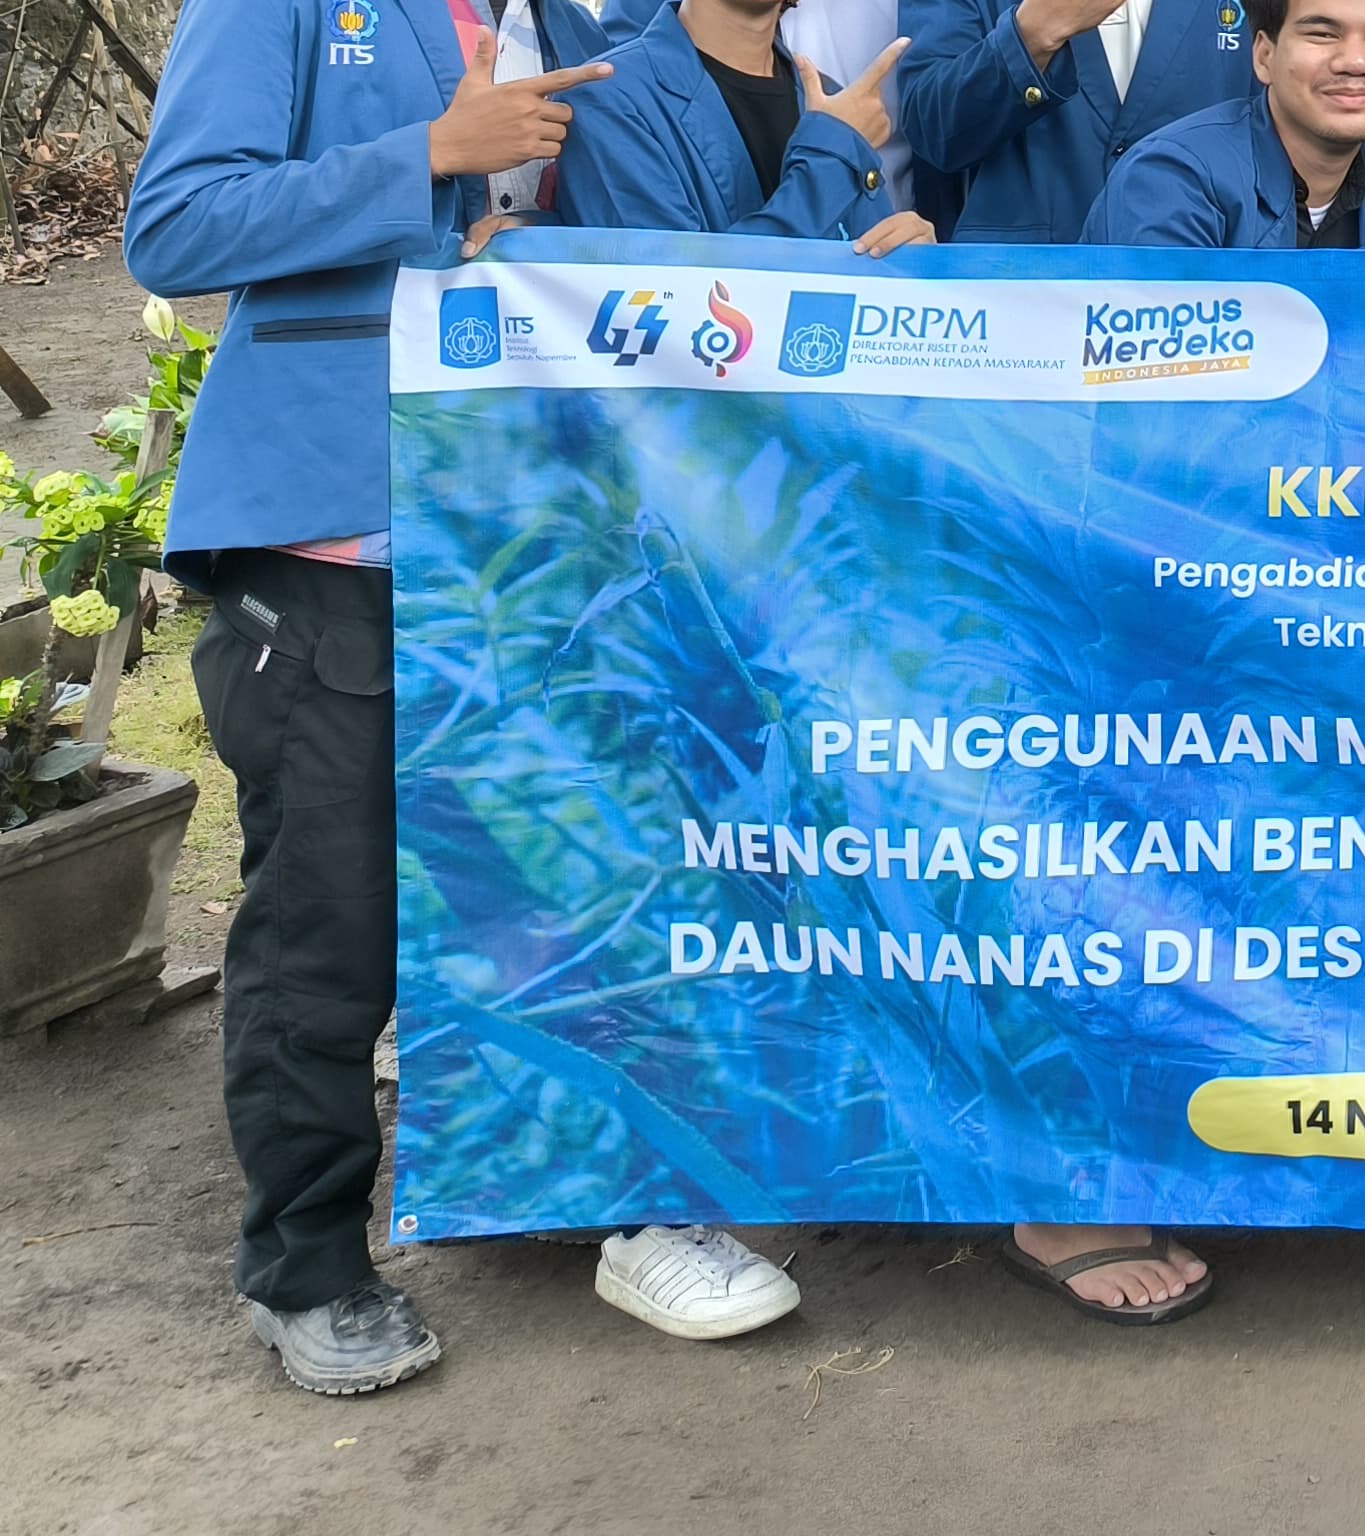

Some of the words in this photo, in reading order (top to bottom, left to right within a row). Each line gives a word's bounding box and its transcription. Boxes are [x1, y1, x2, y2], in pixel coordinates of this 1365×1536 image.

[329, 42, 376, 65] ITS
[1217, 33, 1240, 49] ITS
[854, 304, 987, 341] DRPM
[1085, 298, 1242, 336] Kampus
[849, 354, 930, 366] PENGABDIAN
[933, 357, 980, 368] KEPADA
[984, 358, 1066, 369] MASYARAKAT
[852, 340, 924, 352] DIREKTORAT
[927, 343, 958, 353] RISET
[960, 344, 989, 353] DAN
[1083, 325, 1254, 367] Merdeka
[1095, 364, 1190, 382] INDONESIA
[1199, 358, 1241, 372] JAYA
[812, 713, 1318, 774] PENGGUNAAN
[682, 819, 1233, 880] MENGHASILKAN
[670, 922, 863, 977] DAUN
[881, 931, 1123, 988] NANAS
[1144, 928, 1212, 985] DI
[1286, 1099, 1334, 1136] 14
